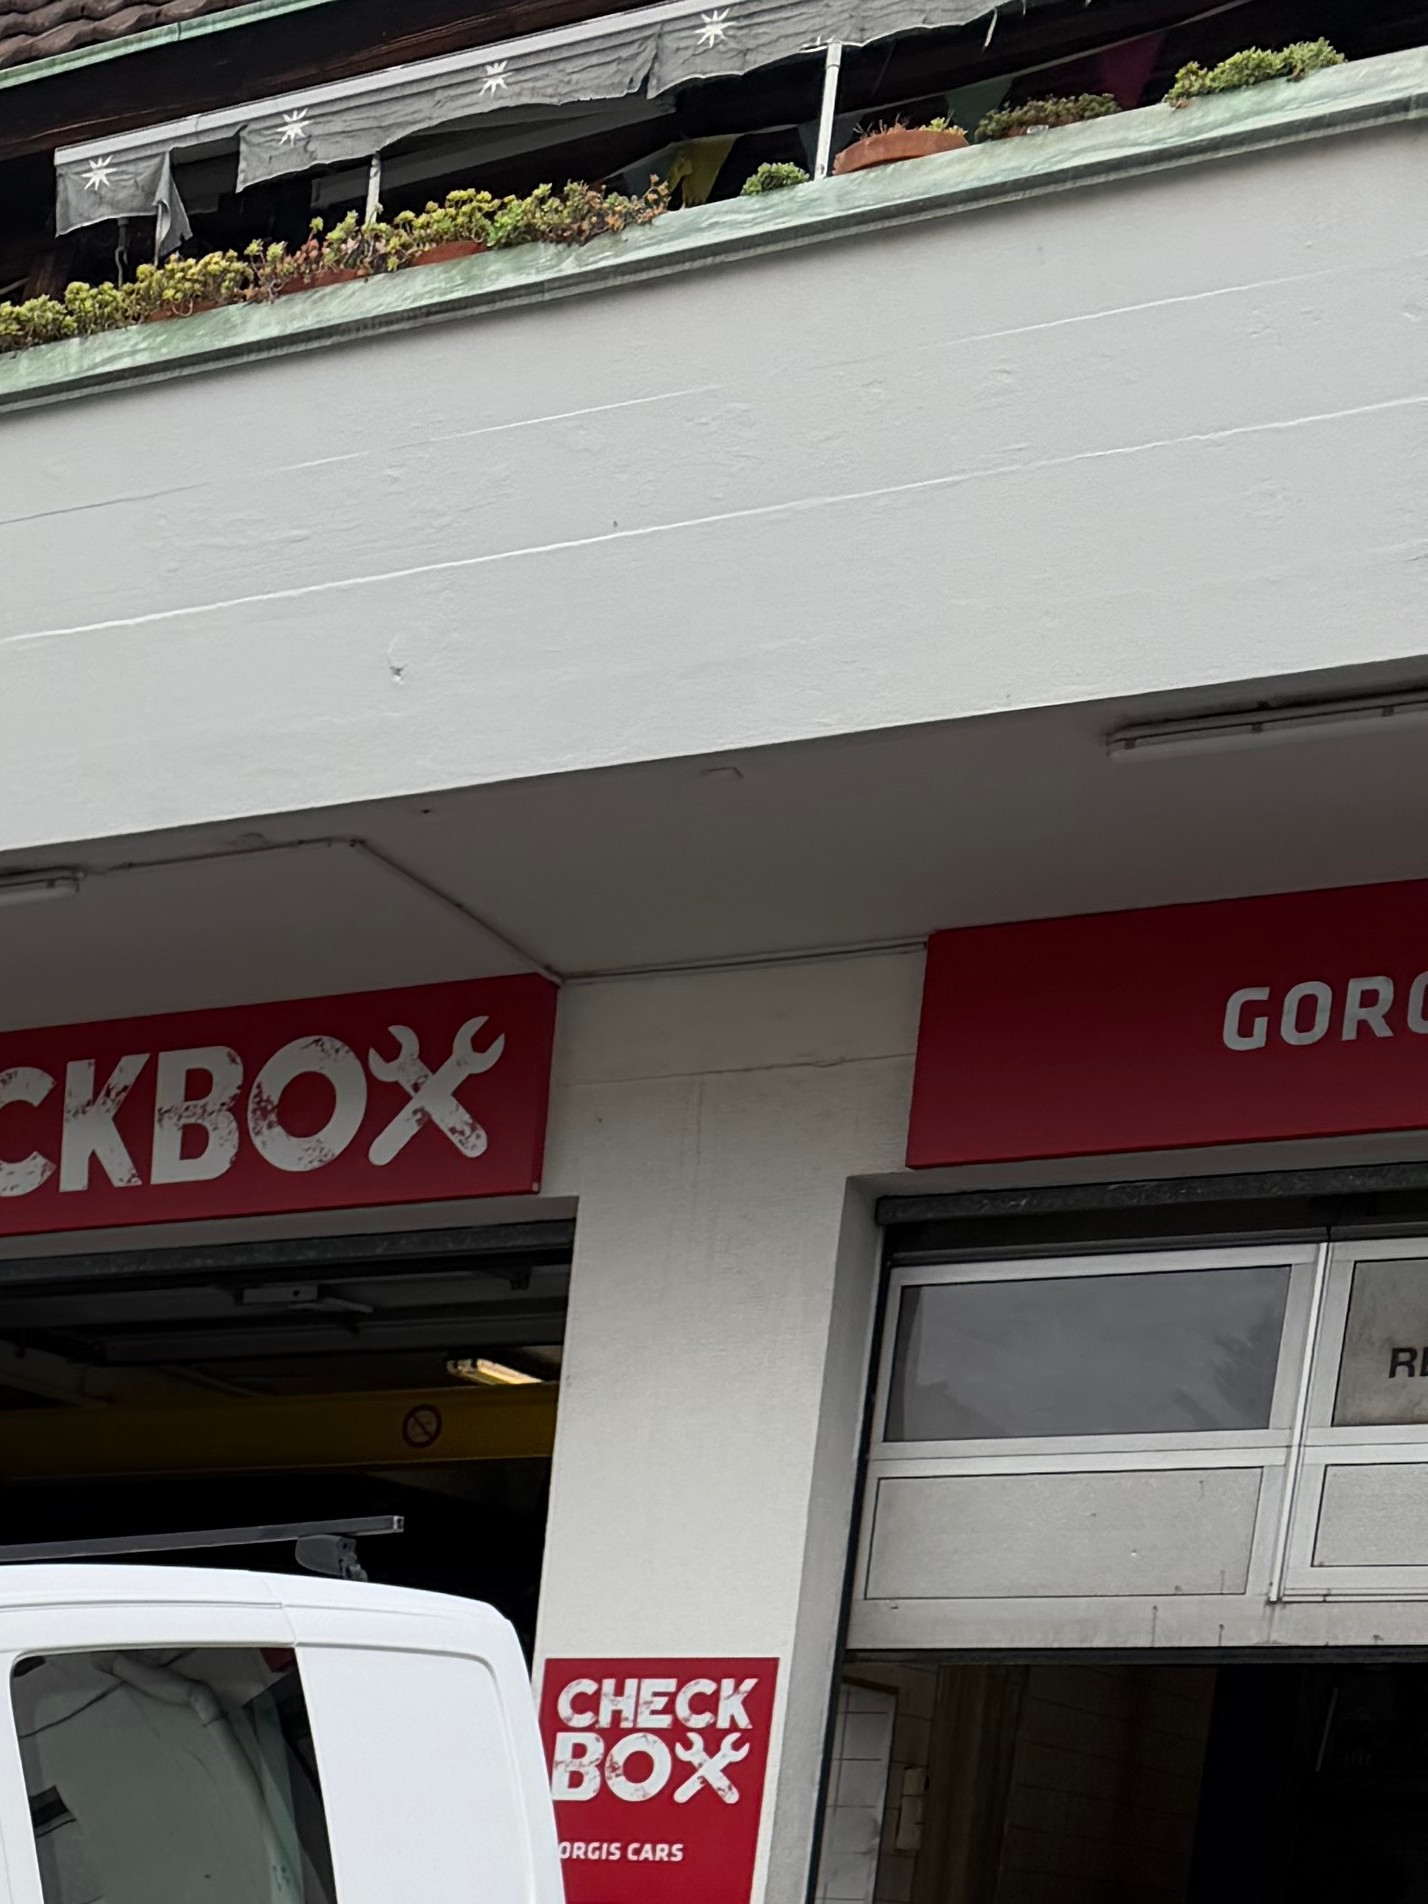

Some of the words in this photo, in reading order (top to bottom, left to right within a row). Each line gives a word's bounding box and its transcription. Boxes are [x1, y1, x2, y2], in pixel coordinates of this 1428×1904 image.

[557, 1678, 759, 1729] CHECK
[559, 1841, 621, 1860] ORGIS
[627, 1842, 684, 1862] CARS
